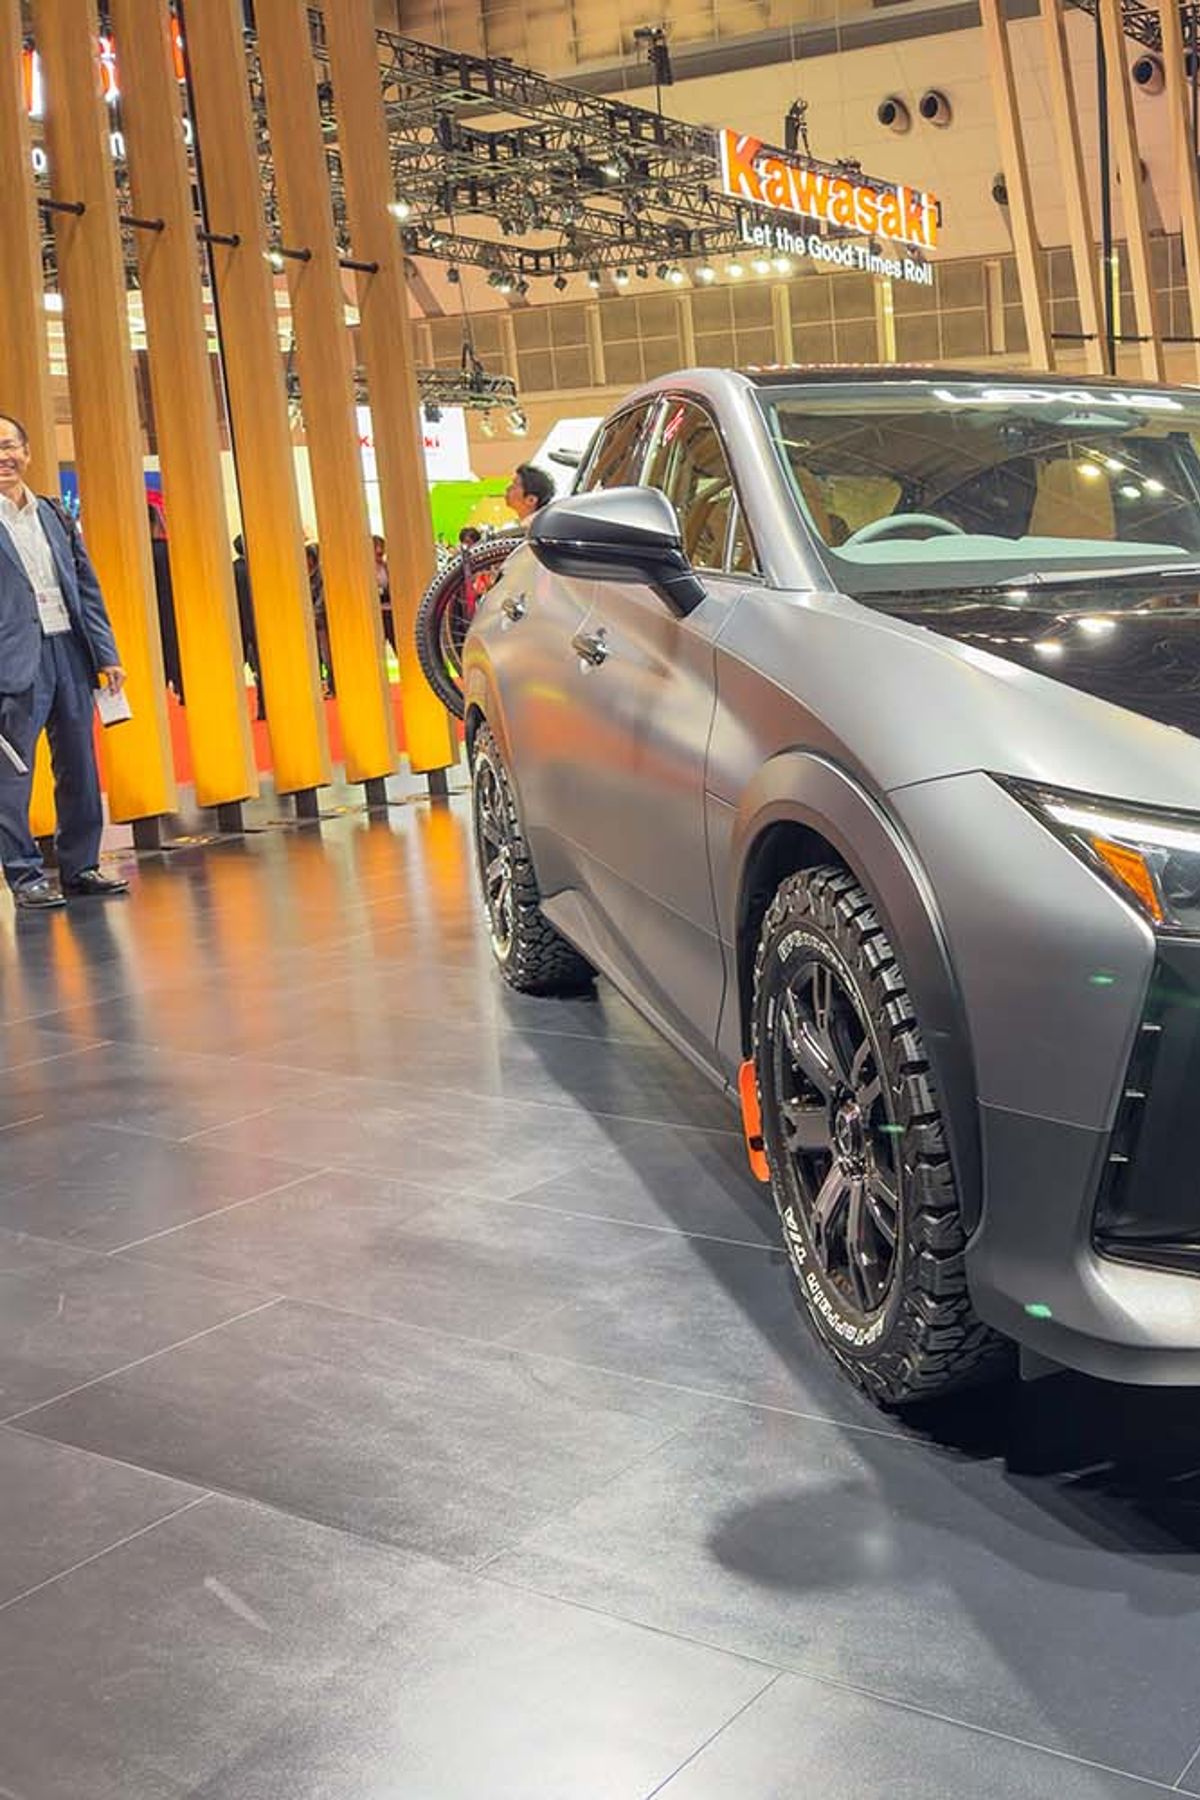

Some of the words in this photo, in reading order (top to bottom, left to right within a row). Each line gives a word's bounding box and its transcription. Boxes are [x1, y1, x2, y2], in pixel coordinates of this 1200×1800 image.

[720, 128, 938, 250] Kawasaki
[742, 217, 772, 247] Let
[777, 227, 804, 254] the
[808, 234, 853, 265] Good
[853, 246, 902, 277] Times
[904, 260, 933, 285] Roll
